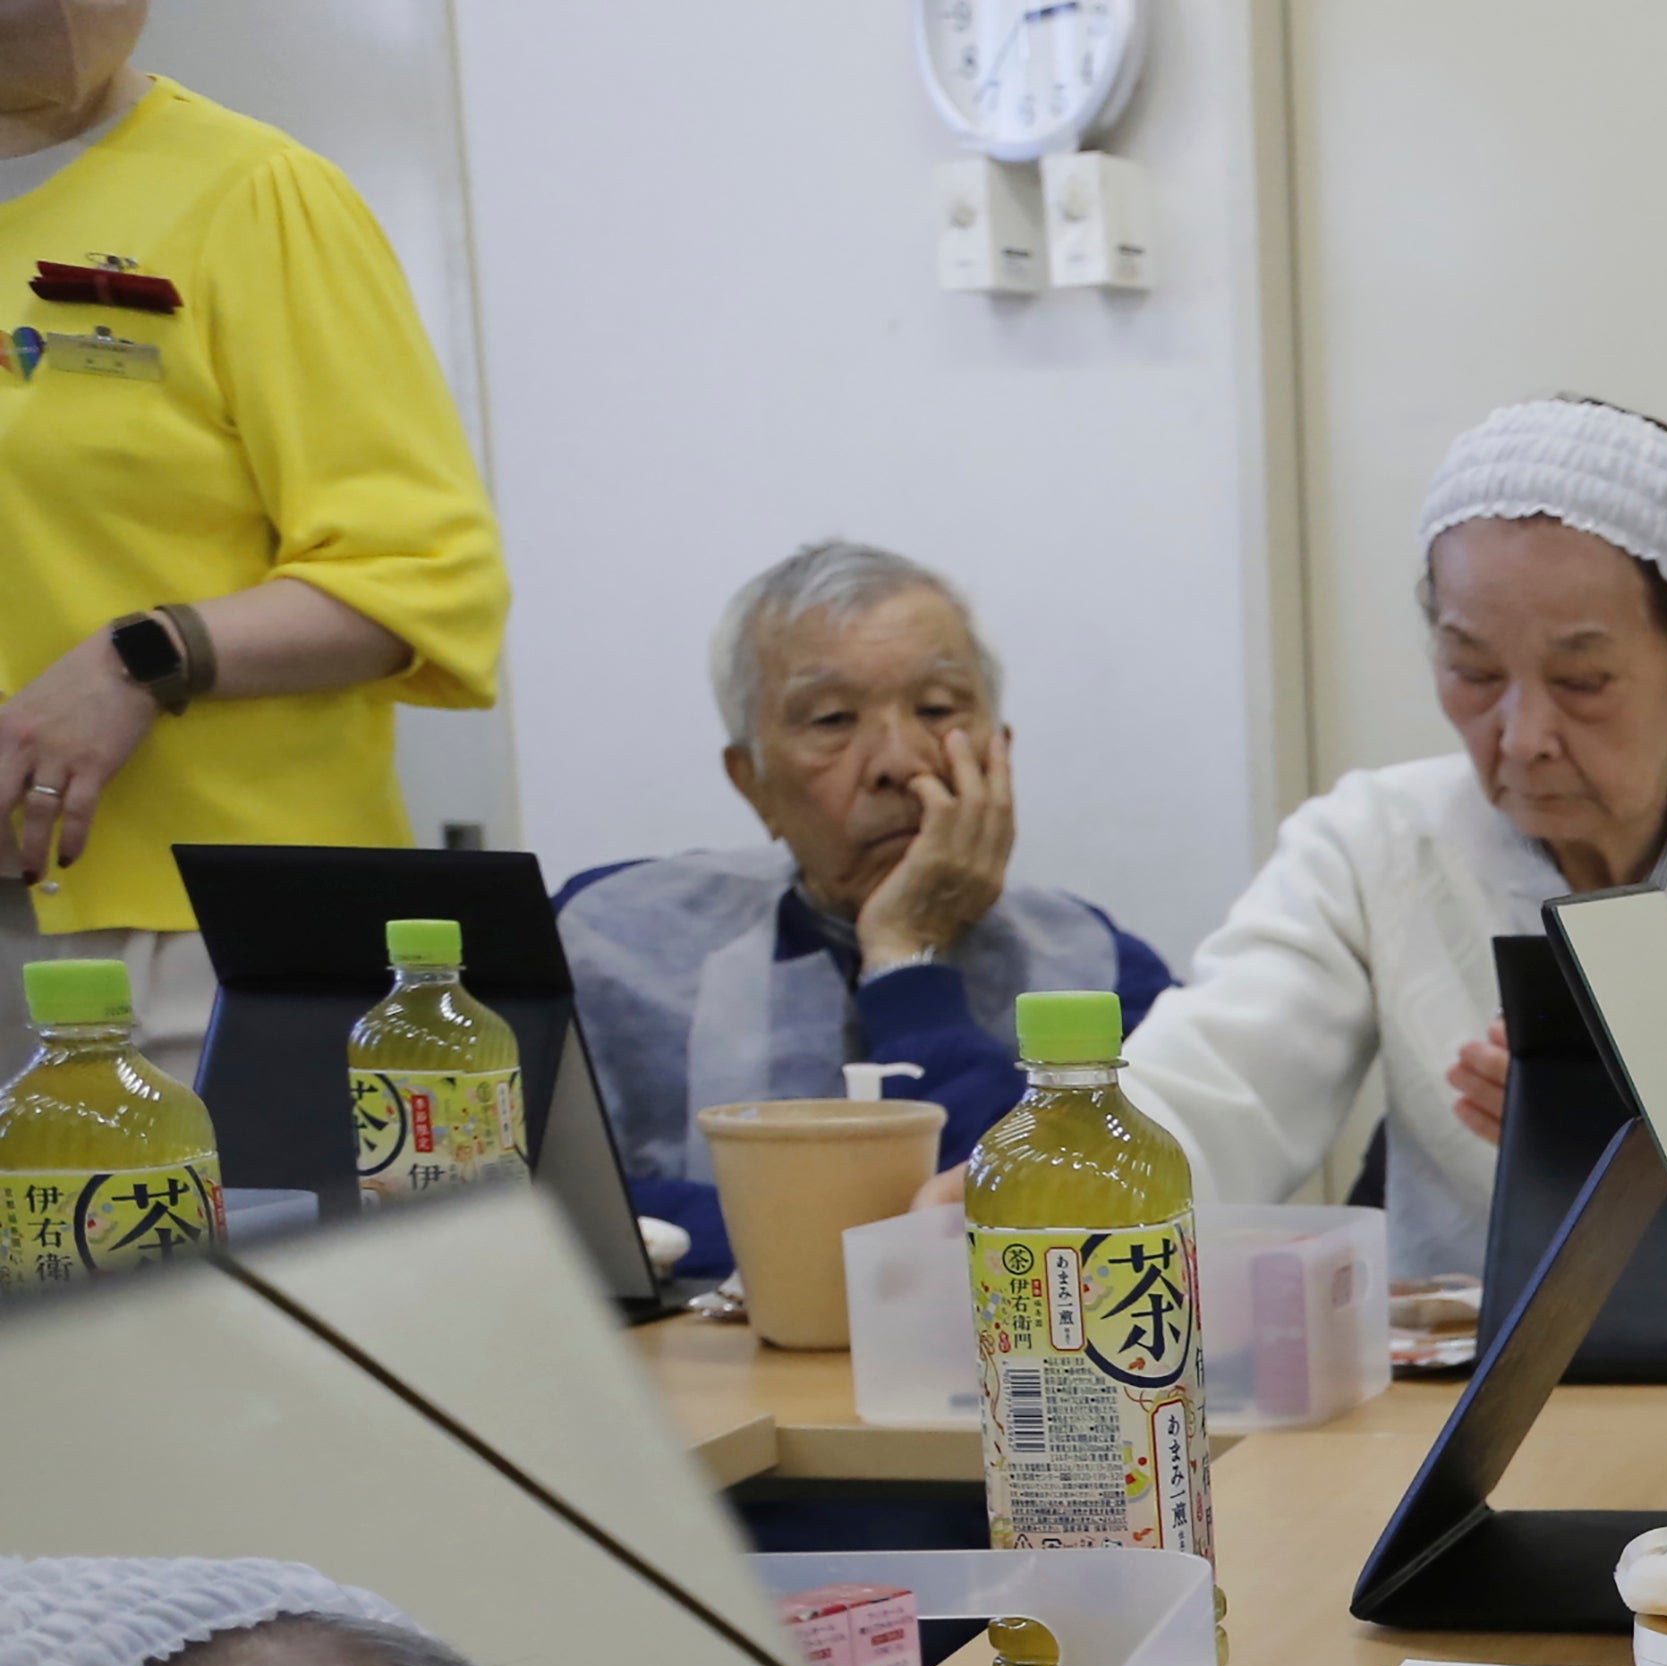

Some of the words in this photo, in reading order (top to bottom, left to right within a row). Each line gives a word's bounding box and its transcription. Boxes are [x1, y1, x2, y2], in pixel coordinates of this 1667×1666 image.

[1010, 1278, 1032, 1350] 伊右衛門
[1056, 1254, 1074, 1325] あまみ一煎
[1100, 1238, 1185, 1362] 茶
[1168, 1414, 1188, 1529] あまみ一煎
